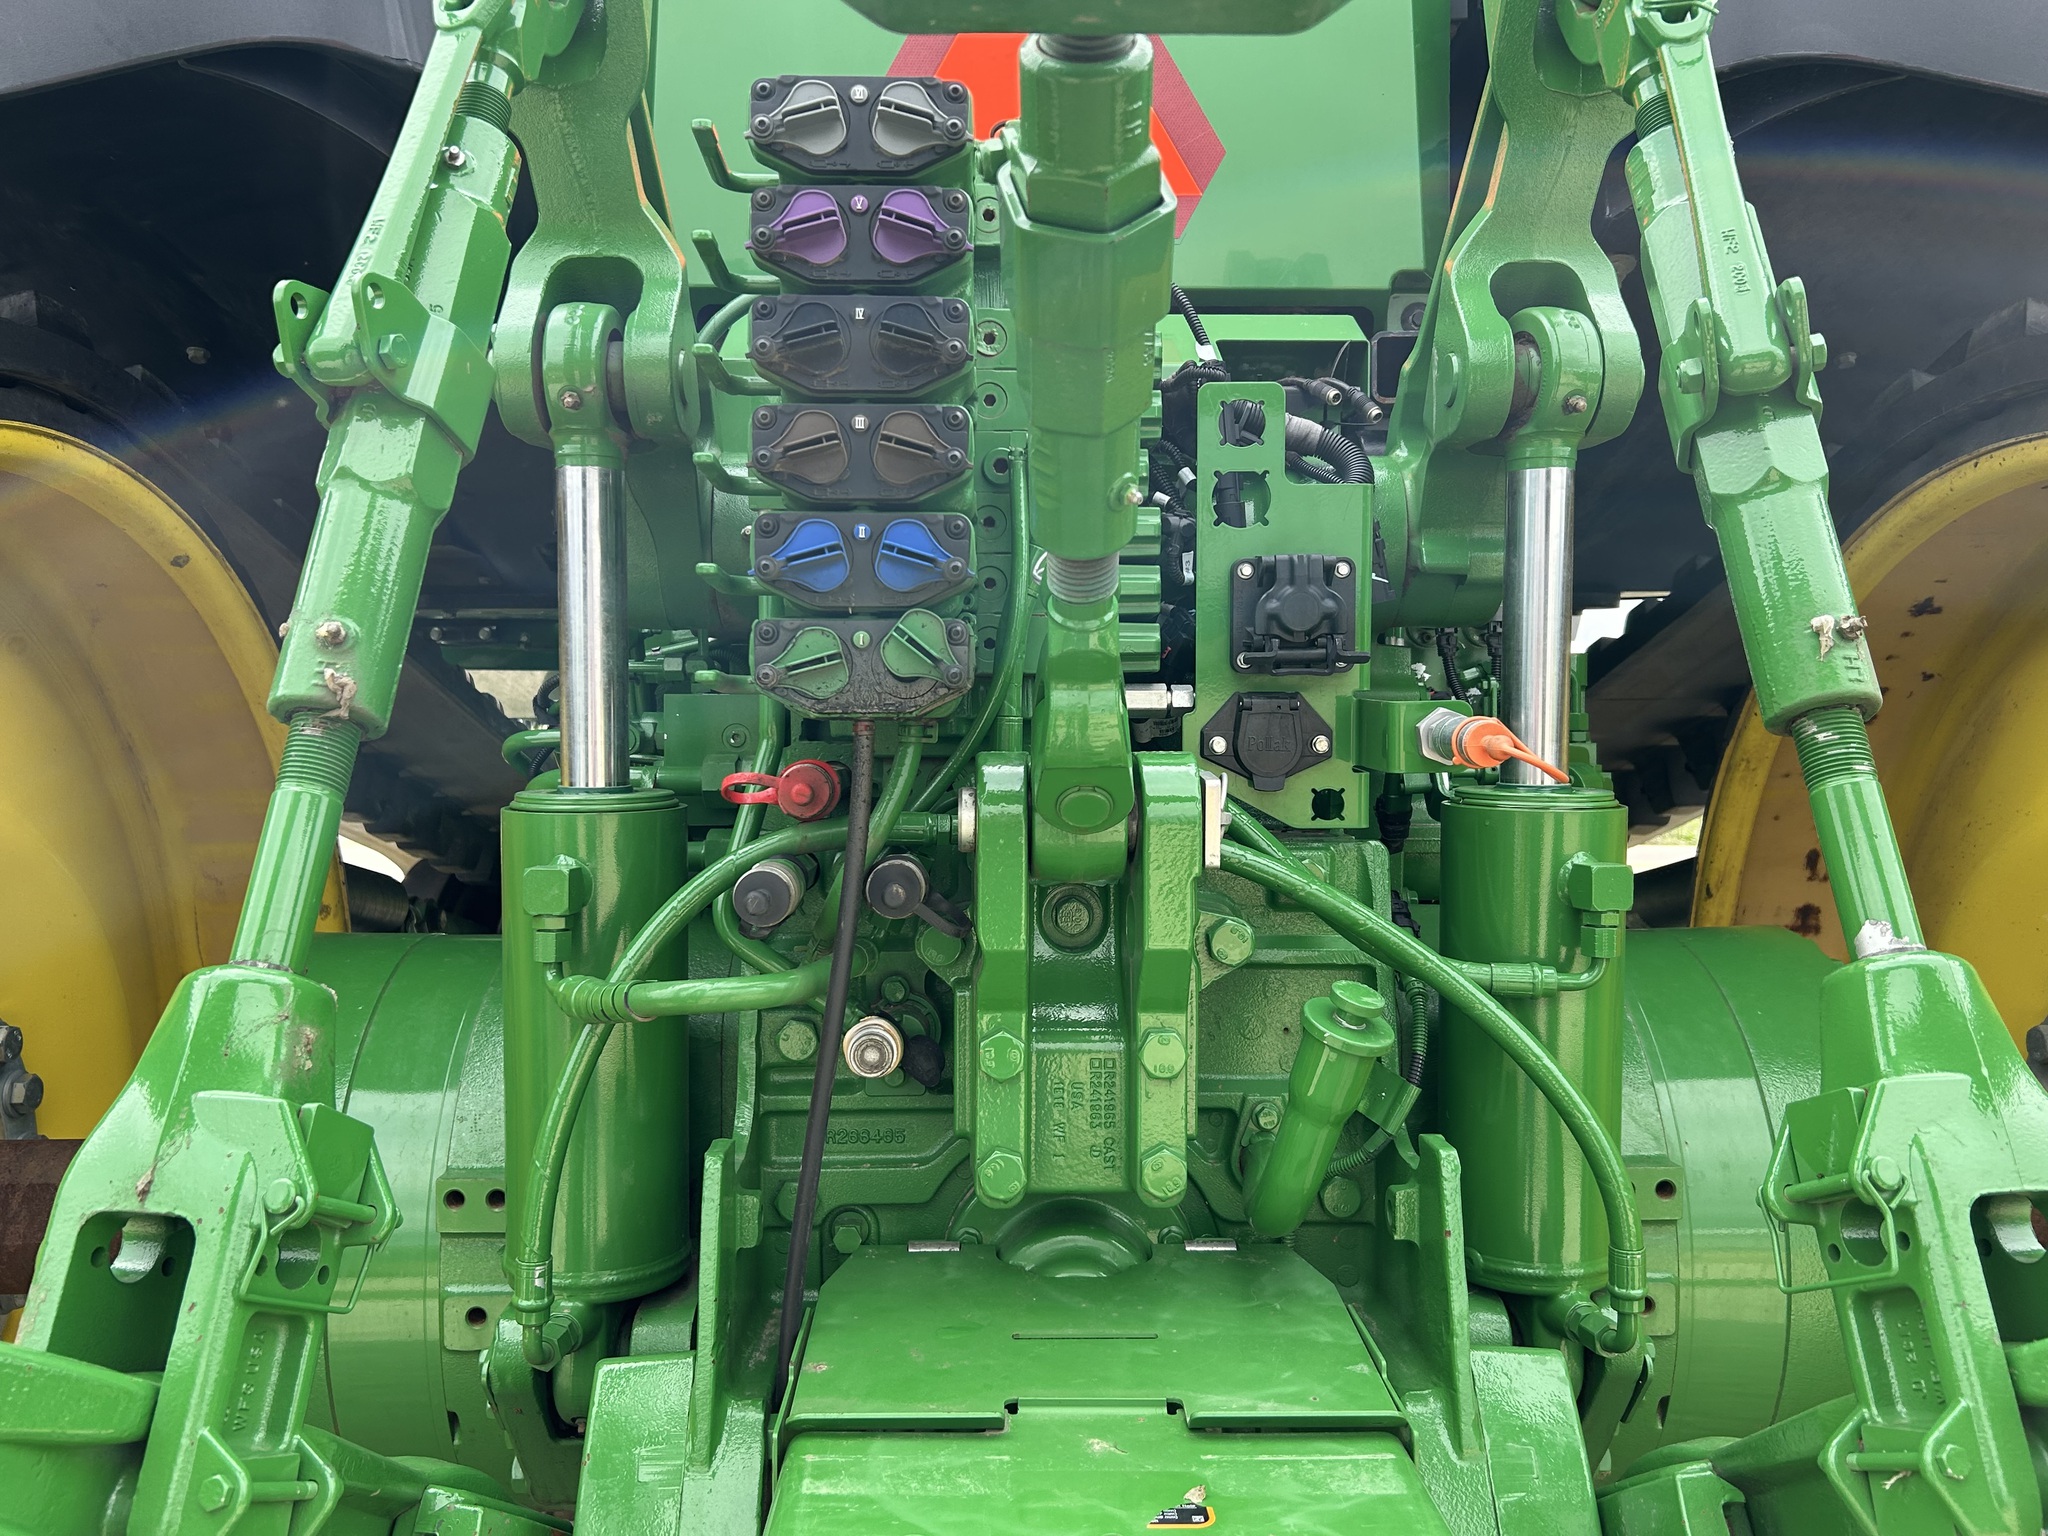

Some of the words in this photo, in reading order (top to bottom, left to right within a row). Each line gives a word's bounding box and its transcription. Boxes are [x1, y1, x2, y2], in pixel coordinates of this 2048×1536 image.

[1247, 735, 1291, 753] Pollak
[1071, 1081, 1084, 1110] USA
[1103, 1136, 1117, 1172] CAST
[246, 1330, 268, 1375] USA
